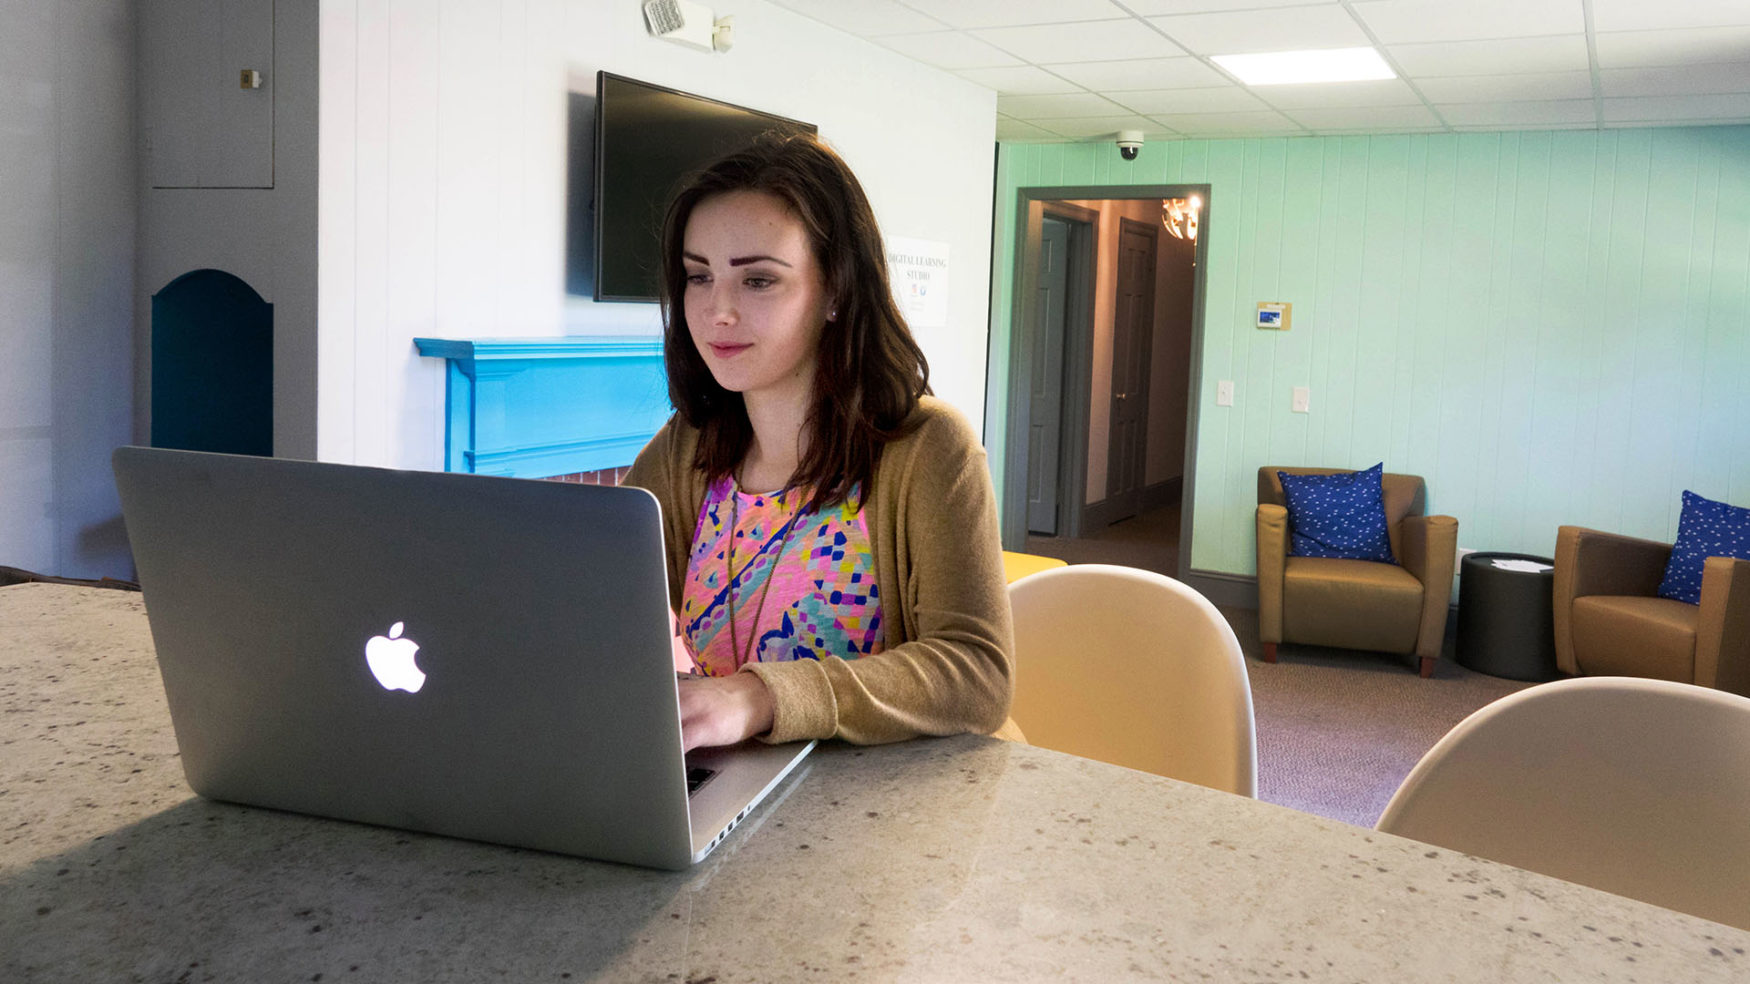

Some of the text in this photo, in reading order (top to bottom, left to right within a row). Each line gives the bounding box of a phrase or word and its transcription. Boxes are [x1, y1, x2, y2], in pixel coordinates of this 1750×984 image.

[888, 253, 946, 268] DIGITAL LEARNING
[907, 270, 930, 280] STUDIO
